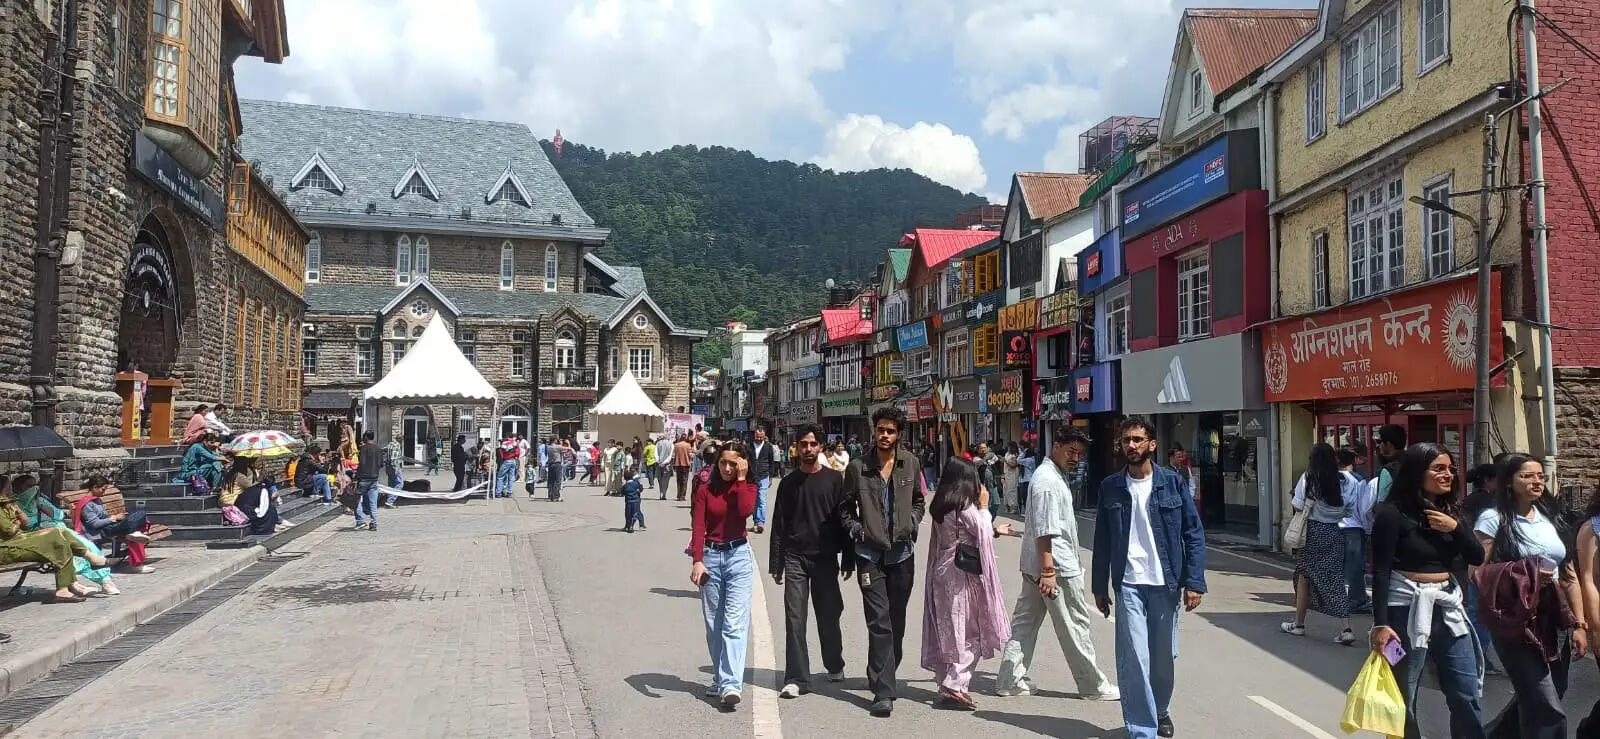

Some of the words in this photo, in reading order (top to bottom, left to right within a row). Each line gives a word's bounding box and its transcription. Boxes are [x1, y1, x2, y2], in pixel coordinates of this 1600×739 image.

[1290, 317, 1373, 364] अग्निशमन
[1380, 297, 1432, 349] केन्द्र
[1005, 352, 1031, 360] xero
[1342, 361, 1357, 374] माल
[1358, 354, 1371, 372] रोड
[1001, 375, 1020, 390] xero
[1365, 372, 1398, 388] 2658976
[987, 389, 1020, 409] degrees
[1041, 391, 1058, 405] Hideout
